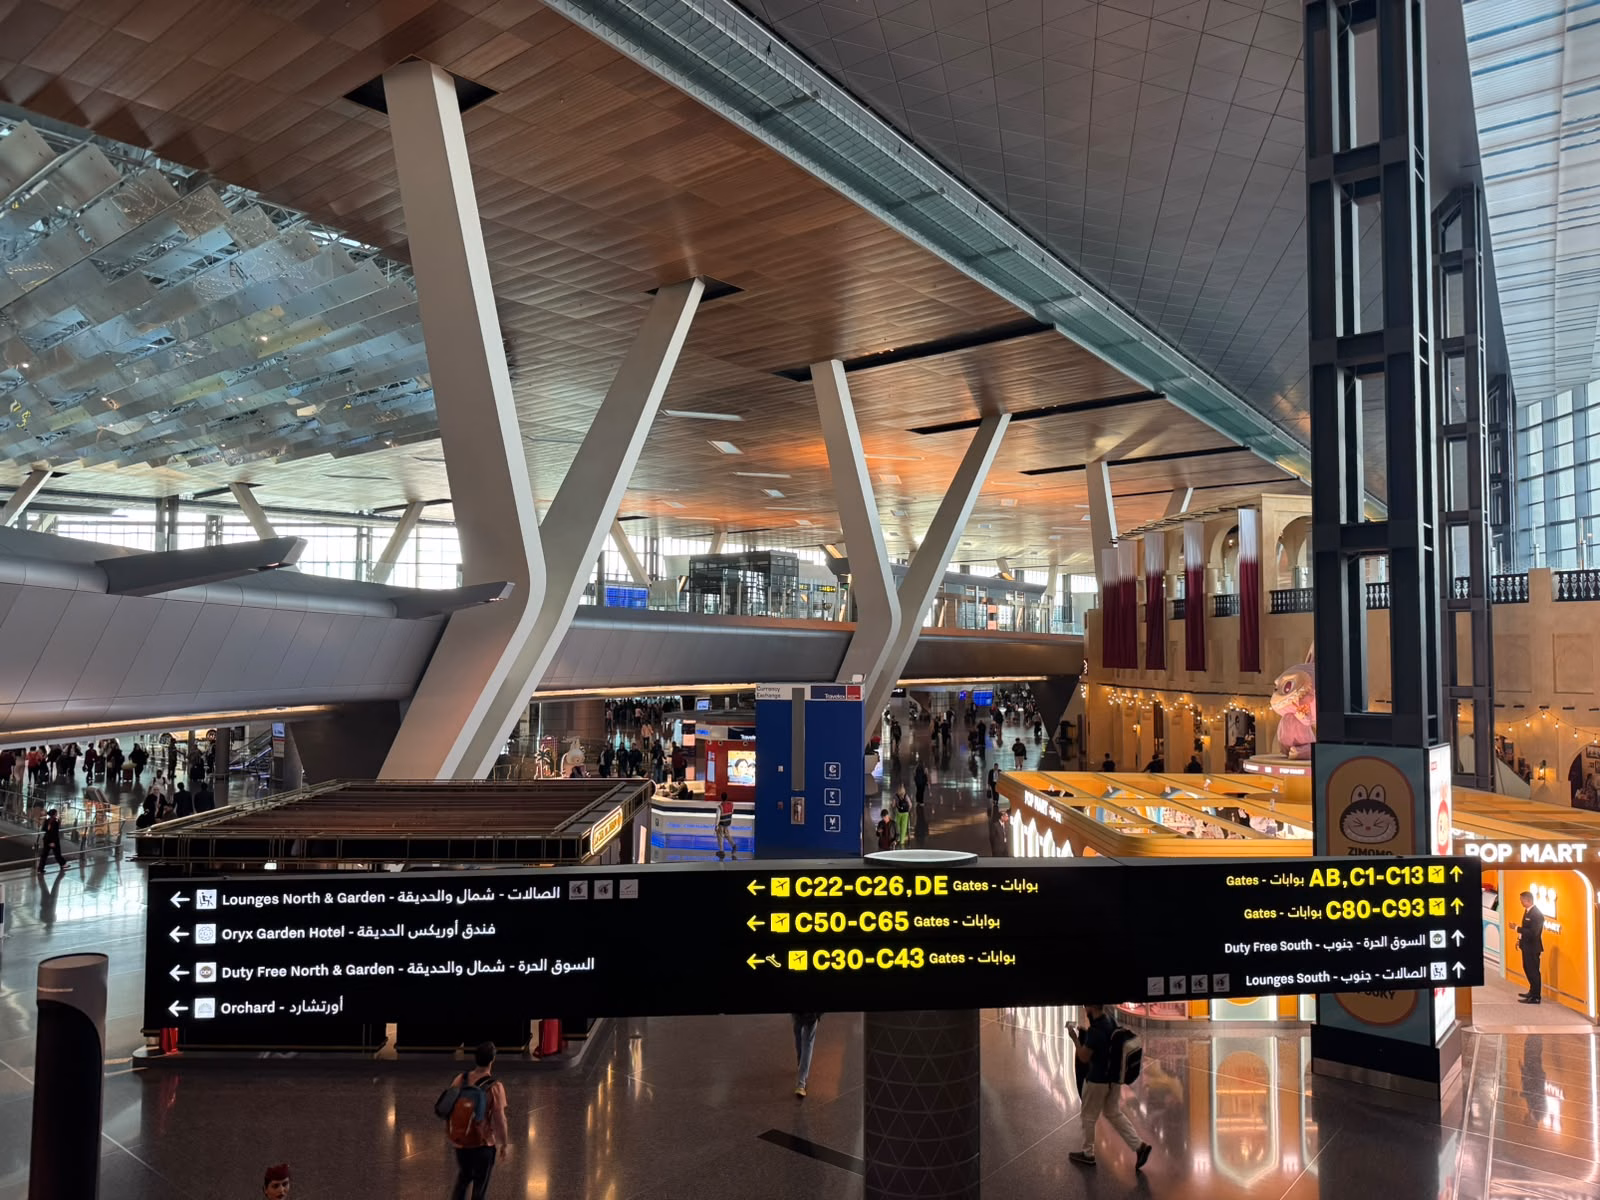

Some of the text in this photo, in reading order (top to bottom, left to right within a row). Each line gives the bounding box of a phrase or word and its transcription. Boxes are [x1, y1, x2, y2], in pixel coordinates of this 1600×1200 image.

[1464, 843, 1588, 863] POP MART
[952, 879, 989, 892] Gates
[1000, 878, 1039, 894] بوابات
[1225, 875, 1260, 886] Gates
[1269, 872, 1305, 888] بوابات
[222, 894, 280, 908] Lounges
[282, 891, 321, 905] North
[323, 892, 334, 904] &
[336, 890, 386, 904] Garden
[397, 889, 453, 905] والحديقة
[456, 887, 495, 905] شمال
[507, 886, 561, 900] الصالات
[1243, 908, 1277, 920] Gates
[1287, 905, 1323, 920] بوابات
[1325, 898, 1425, 921] C80-C93
[356, 919, 496, 940] فندق أوريكس الحديقة
[794, 910, 910, 933] C50-C65
[913, 915, 951, 928] Gates
[961, 913, 1001, 930] بوابات
[221, 928, 254, 943] Oryx
[256, 925, 306, 940] Garden
[309, 925, 345, 939] Hotel
[1390, 933, 1426, 951] السوق
[1224, 942, 1251, 955] Duty
[1253, 941, 1278, 953] Free
[1279, 938, 1313, 952] South
[1322, 938, 1354, 952] جنوب
[1363, 935, 1388, 951] الحرة
[517, 958, 548, 975] الحرة
[550, 957, 595, 976] السوق
[812, 947, 925, 971] C30-C43
[928, 952, 966, 965] Gates
[977, 950, 1016, 967] بوابات
[221, 966, 254, 982] Duty
[257, 966, 288, 978] Free
[290, 963, 330, 977] North
[332, 964, 343, 976] &
[345, 962, 395, 976] Garden
[406, 960, 464, 977] والحديقة
[466, 959, 506, 976] شمال
[1381, 965, 1427, 980] الصالات
[1245, 974, 1295, 988] Lounges
[1296, 970, 1331, 984] South
[1340, 970, 1372, 985] جنوب
[220, 1000, 276, 1015] Orchard
[289, 995, 344, 1016] أورتشارد
